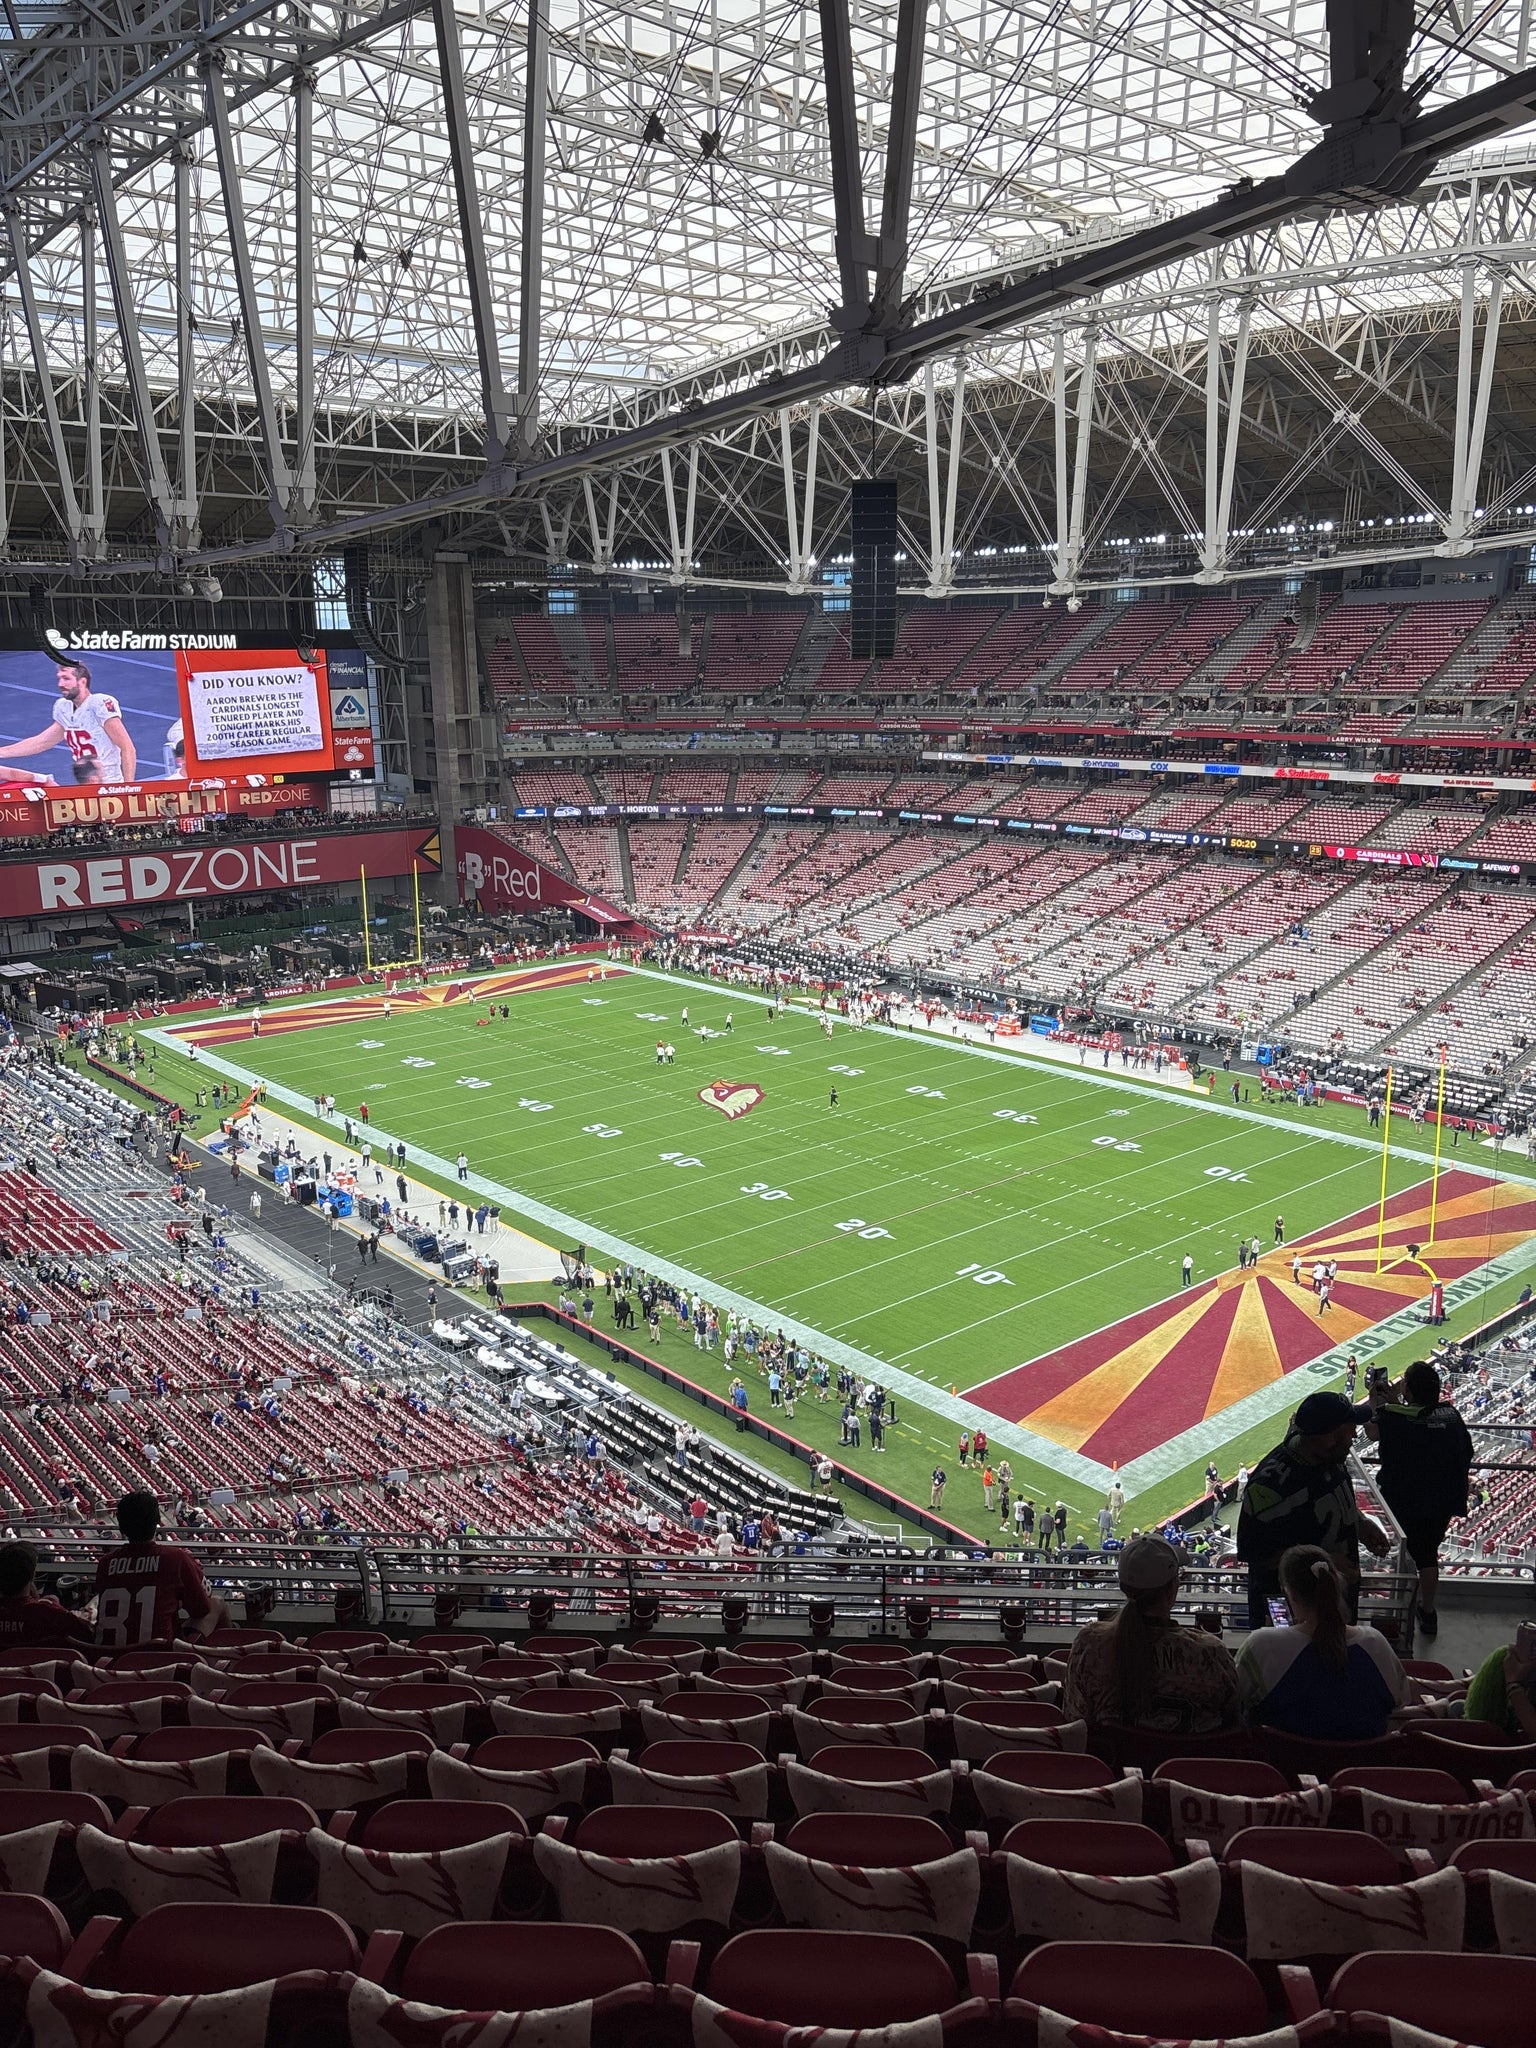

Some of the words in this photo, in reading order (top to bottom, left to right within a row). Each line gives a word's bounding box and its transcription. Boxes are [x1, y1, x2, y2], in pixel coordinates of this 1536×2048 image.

[169, 634, 237, 649] STADIUM
[202, 679, 224, 689] DID
[228, 677, 254, 688] YOU
[258, 673, 303, 686] KNOW?
[206, 696, 238, 705] AARON
[239, 693, 276, 703] BREWER
[278, 693, 286, 701] IS
[287, 692, 304, 700] THE
[212, 702, 261, 714] CARDINALS
[263, 701, 300, 710] LONGEST
[210, 712, 250, 723] TENURED
[252, 711, 284, 720] PLAYER
[286, 709, 304, 717] AND
[215, 722, 253, 731] TONIGHT
[255, 720, 285, 729] MARKS
[287, 718, 302, 726] HIS
[207, 731, 235, 741] 200TH
[236, 729, 270, 739] CAREER
[272, 726, 311, 736] REGULAR
[230, 738, 264, 748] SEASON
[266, 736, 291, 745] GAME
[1092, 760, 1120, 768] HYUNDAI
[1150, 763, 1168, 771] COX
[350, 770, 361, 779] 25
[239, 788, 312, 806] REDZONE
[51, 797, 124, 824] BUD
[128, 790, 220, 818] LIGHT
[1150, 831, 1187, 841] SEAHAWKS
[1192, 834, 1200, 844] 0
[1230, 838, 1257, 849] 50:20
[1336, 847, 1345, 857] 0
[1356, 850, 1402, 860] CARDINALS
[1482, 863, 1511, 872] SAFEWAY
[37, 841, 321, 910] REDZONE
[264, 987, 303, 998] ARDINALS
[756, 1045, 792, 1056] 40
[827, 1064, 866, 1077] 50
[455, 1077, 492, 1089] 30
[905, 1085, 944, 1099] 40
[518, 1099, 554, 1113] 40
[992, 1109, 1037, 1124] 30
[581, 1123, 623, 1138] 50
[1091, 1135, 1141, 1152] 20
[658, 1151, 699, 1168] 40
[1203, 1166, 1247, 1182] 10
[740, 1182, 788, 1201] 30
[833, 1218, 889, 1240] 20
[955, 1263, 1006, 1285] 10
[1347, 1335, 1386, 1357] OF
[1307, 1353, 1350, 1377] US
[108, 1555, 160, 1576] BOLDIN
[96, 1585, 157, 1646] 81
[1370, 1809, 1417, 1841] TO
[1430, 1810, 1524, 1845] BUILT
